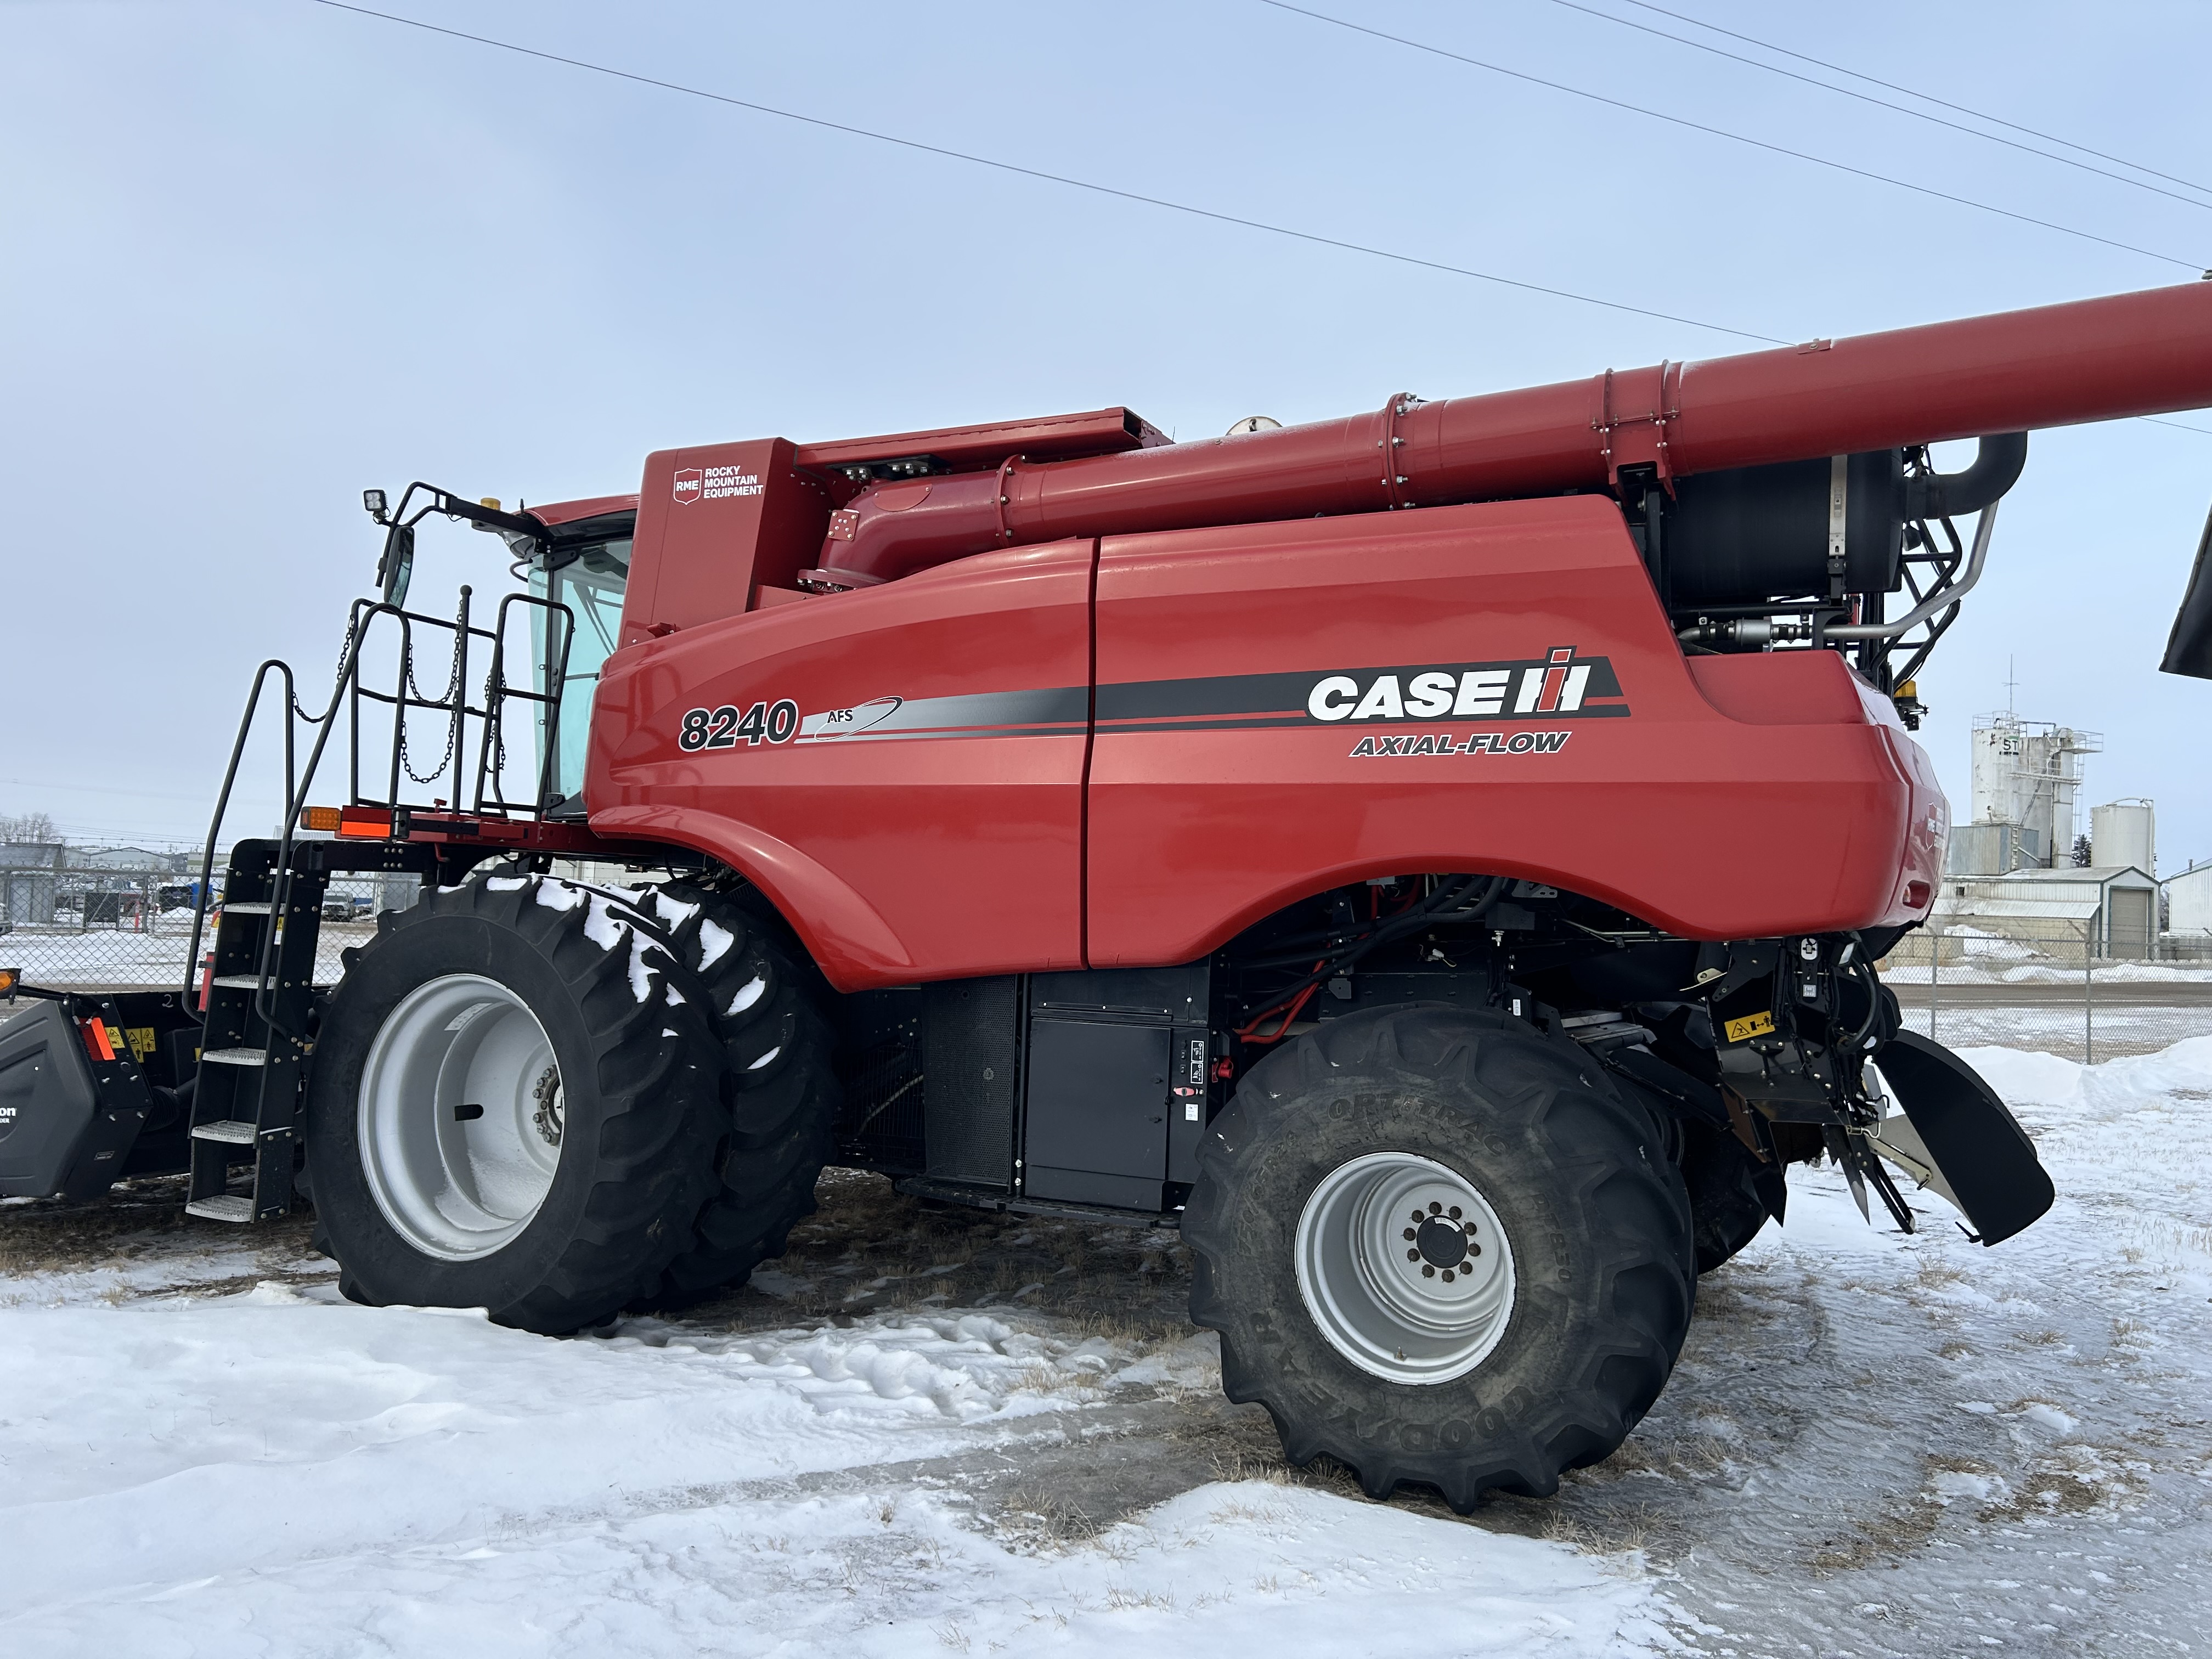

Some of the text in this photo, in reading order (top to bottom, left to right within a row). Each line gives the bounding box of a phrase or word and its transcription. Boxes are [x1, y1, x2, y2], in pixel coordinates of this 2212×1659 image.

[704, 465, 741, 476] ROCKY
[675, 480, 699, 493] RME
[704, 475, 758, 487] MOUNTAIN
[703, 484, 764, 499] EQUIPMENT
[1308, 670, 1510, 721] CASE
[827, 709, 853, 724] AFS
[679, 698, 799, 752] 8240
[1349, 731, 1572, 757] AXIAL-FLOW
[162, 994, 174, 1008] 2
[1327, 1093, 1510, 1155] OPTITRAC
[1531, 1193, 1573, 1284] DT830
